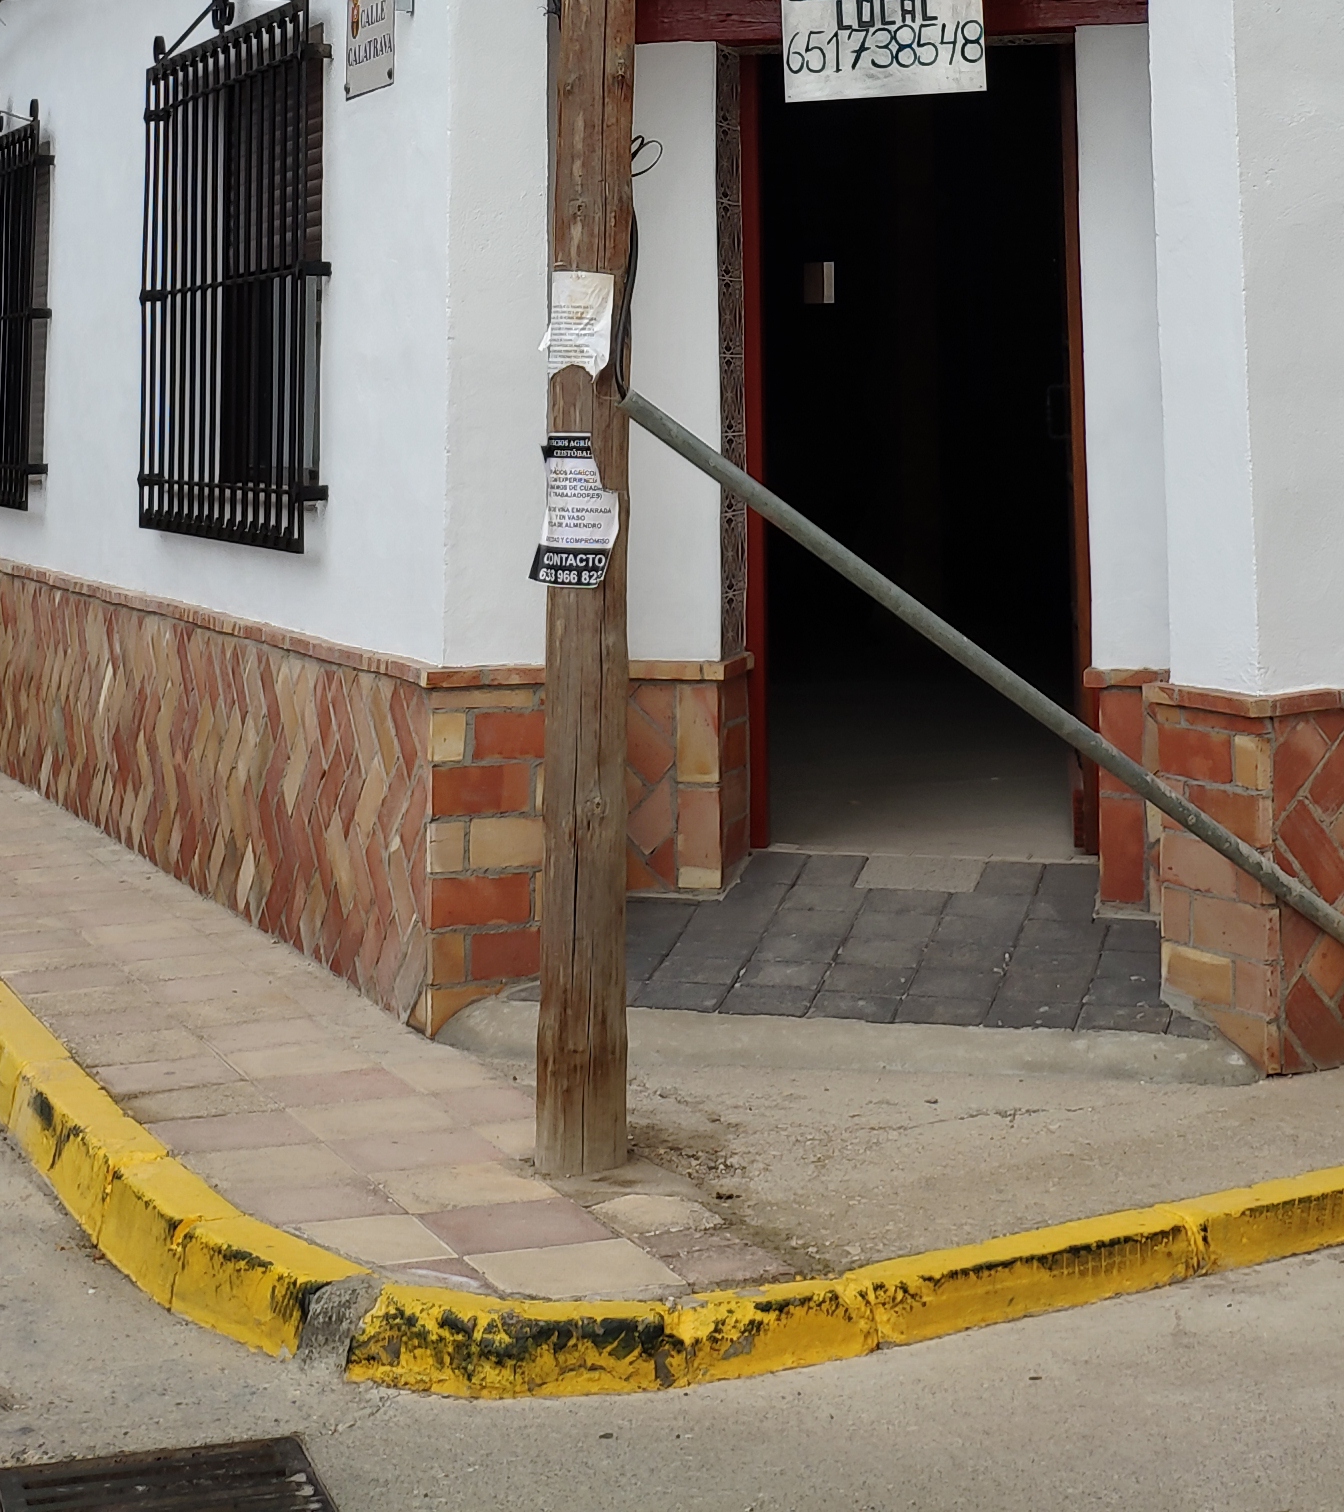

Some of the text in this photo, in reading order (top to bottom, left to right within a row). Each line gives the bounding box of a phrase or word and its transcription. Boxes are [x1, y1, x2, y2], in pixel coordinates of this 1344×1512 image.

[360, 0, 386, 29] CALLE
[347, 33, 393, 67] CALATRAVA
[785, 19, 984, 74] 651738548
[544, 552, 606, 567] CONTACTO
[557, 569, 577, 583] 966
